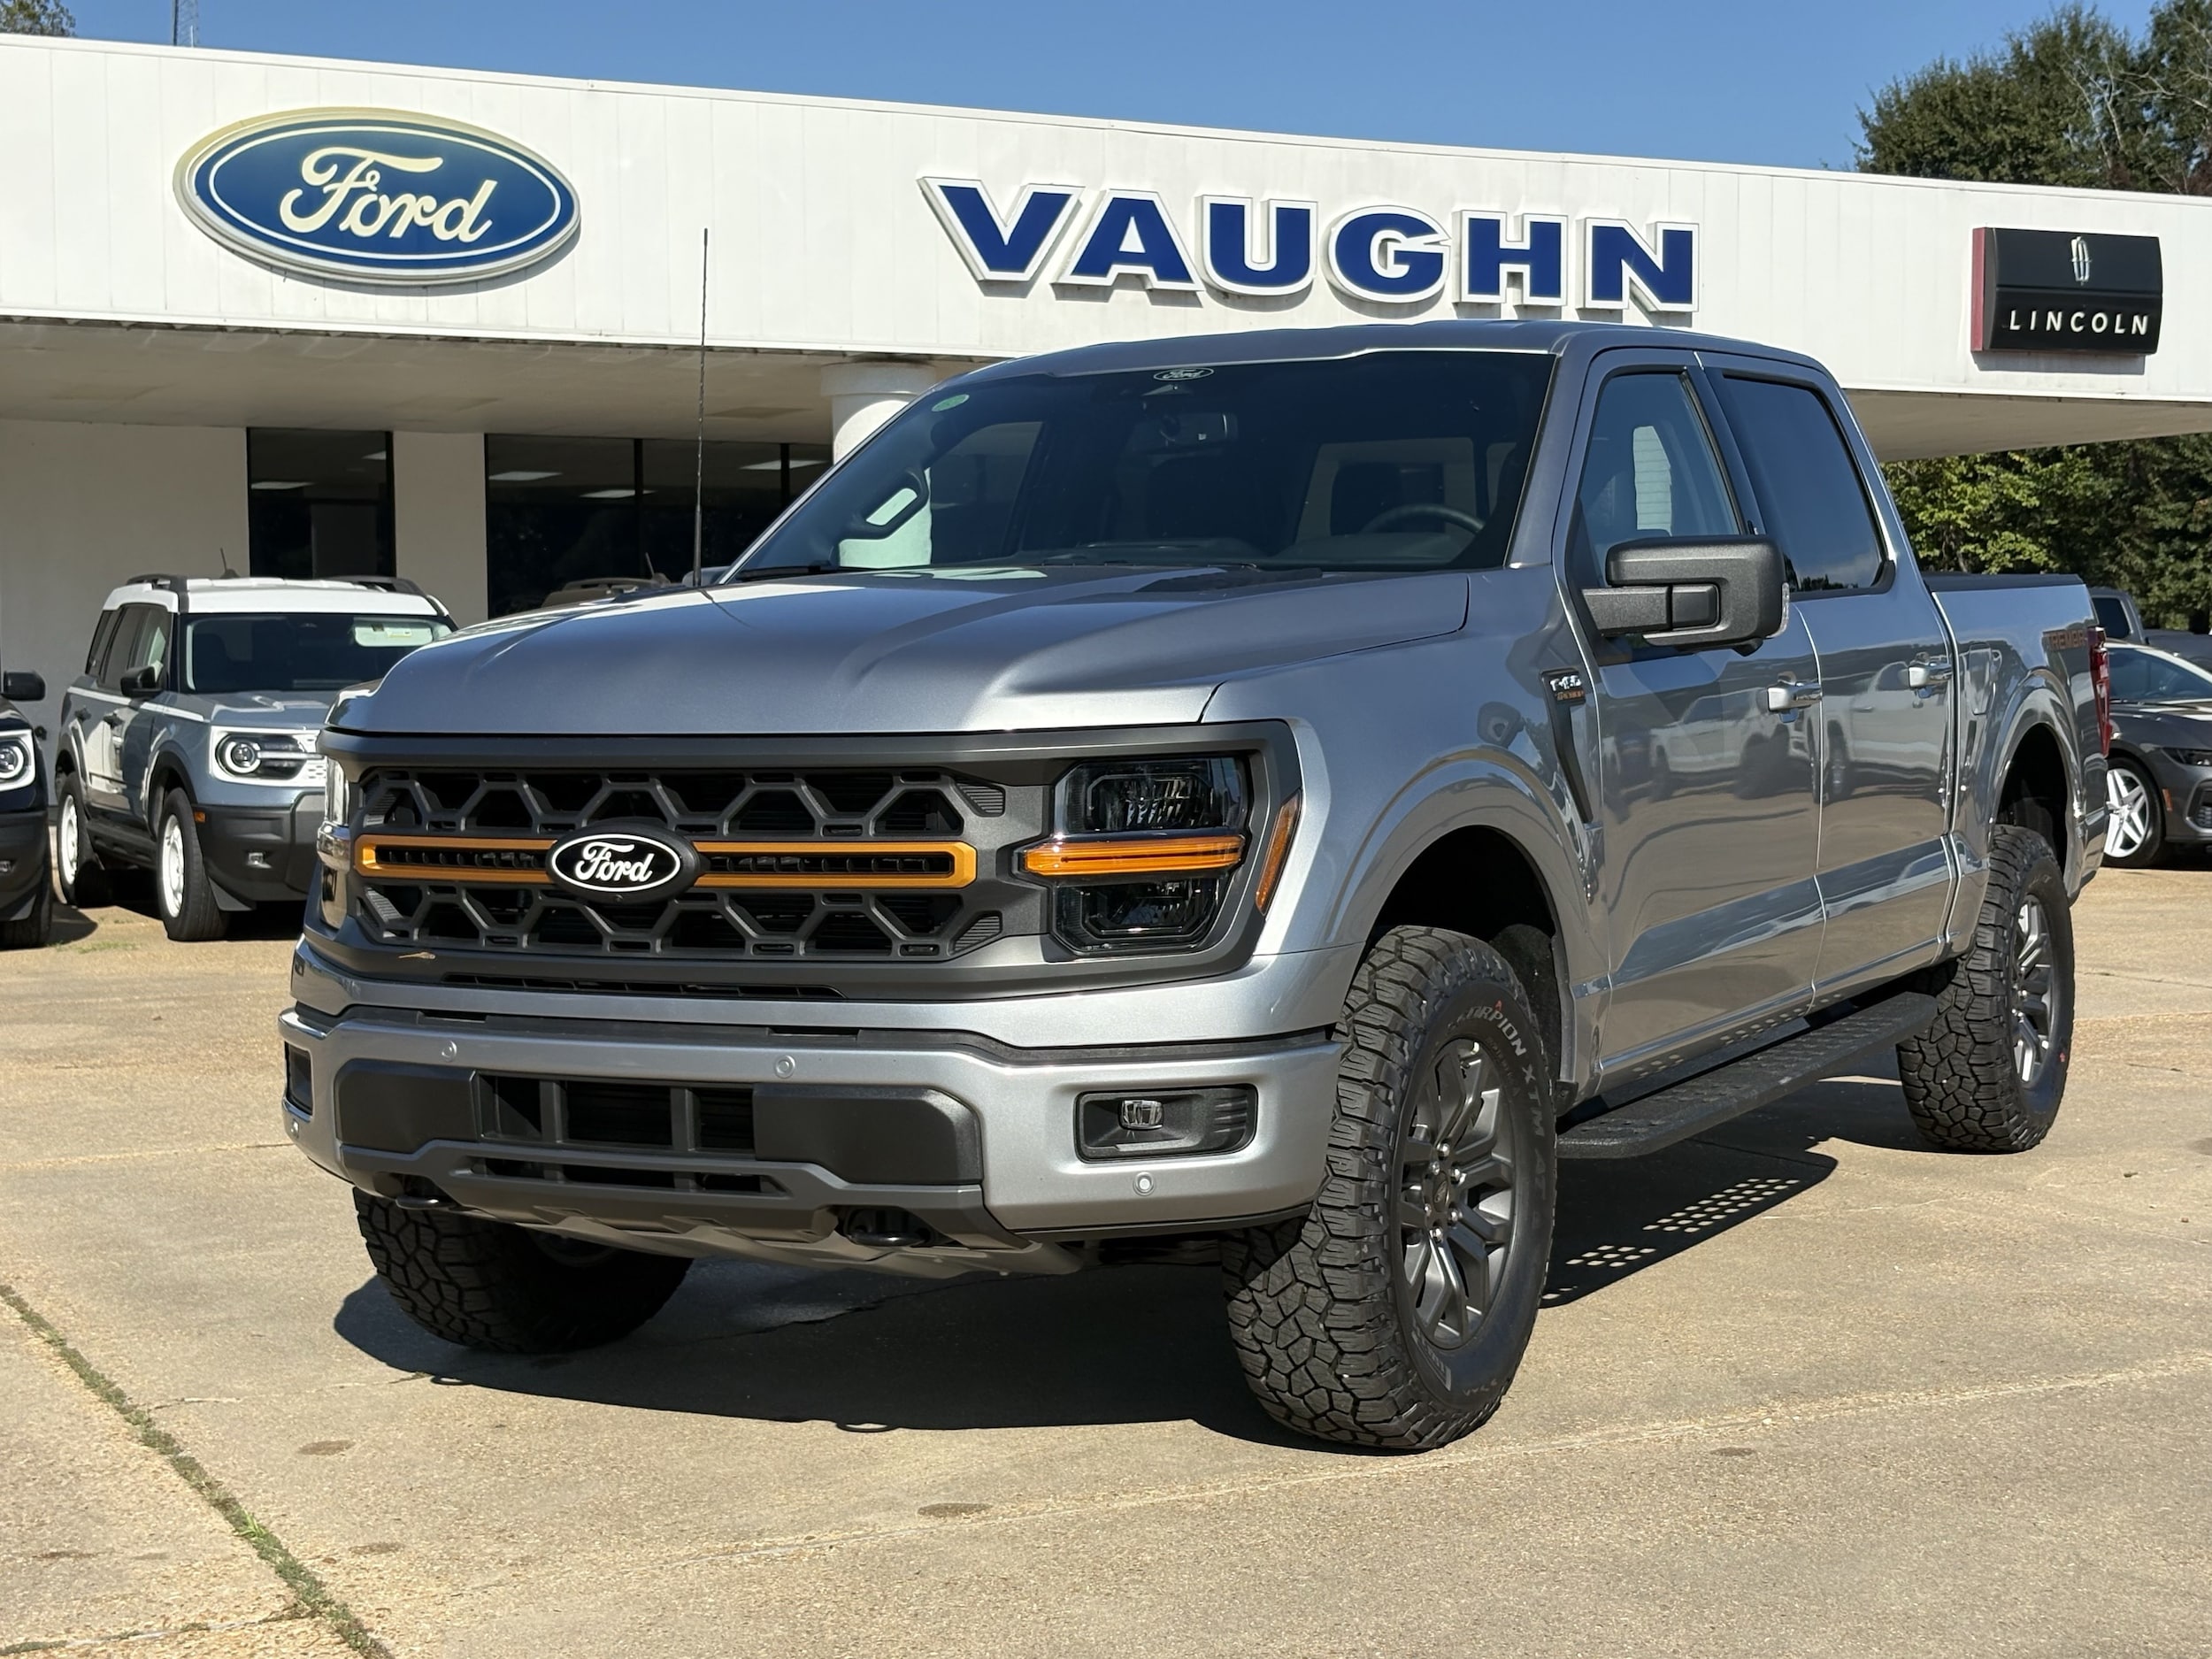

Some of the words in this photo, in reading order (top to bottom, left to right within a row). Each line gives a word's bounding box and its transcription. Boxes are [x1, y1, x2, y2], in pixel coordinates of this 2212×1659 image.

[279, 146, 498, 242] Ford
[925, 180, 1700, 312] VAUGHN
[2009, 310, 2148, 335] LINCOLN
[1163, 369, 1204, 379] Ford
[575, 841, 655, 882] Ford
